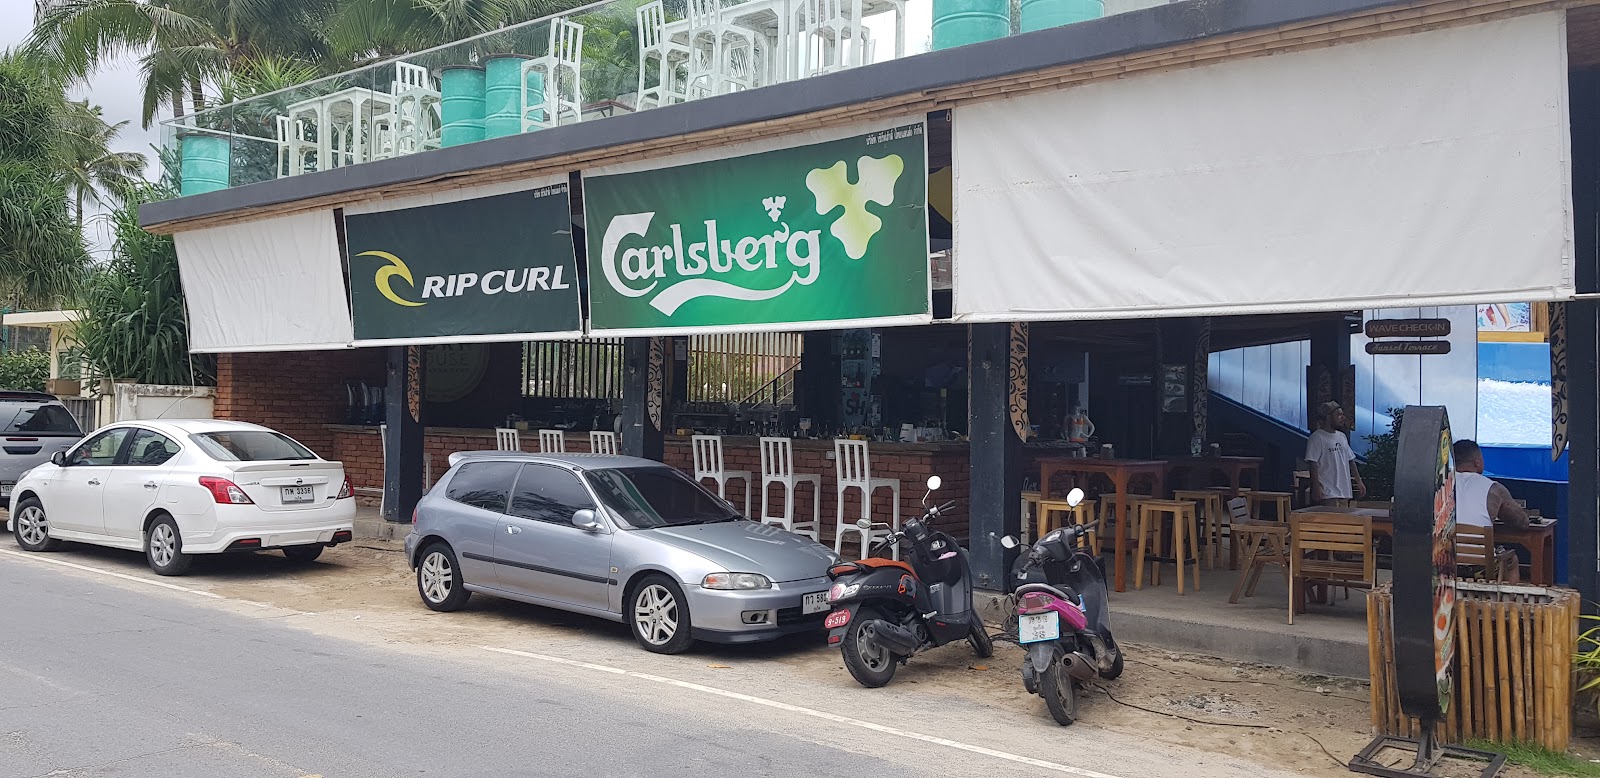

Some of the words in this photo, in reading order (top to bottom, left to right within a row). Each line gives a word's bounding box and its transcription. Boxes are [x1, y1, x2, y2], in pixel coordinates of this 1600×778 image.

[601, 211, 822, 298] Carlsberg
[421, 272, 478, 299] RIP
[480, 265, 570, 295] CURL
[1369, 324, 1398, 333] WAVE
[1399, 323, 1446, 332] CHECK-IN
[1403, 342, 1438, 351] Terrace
